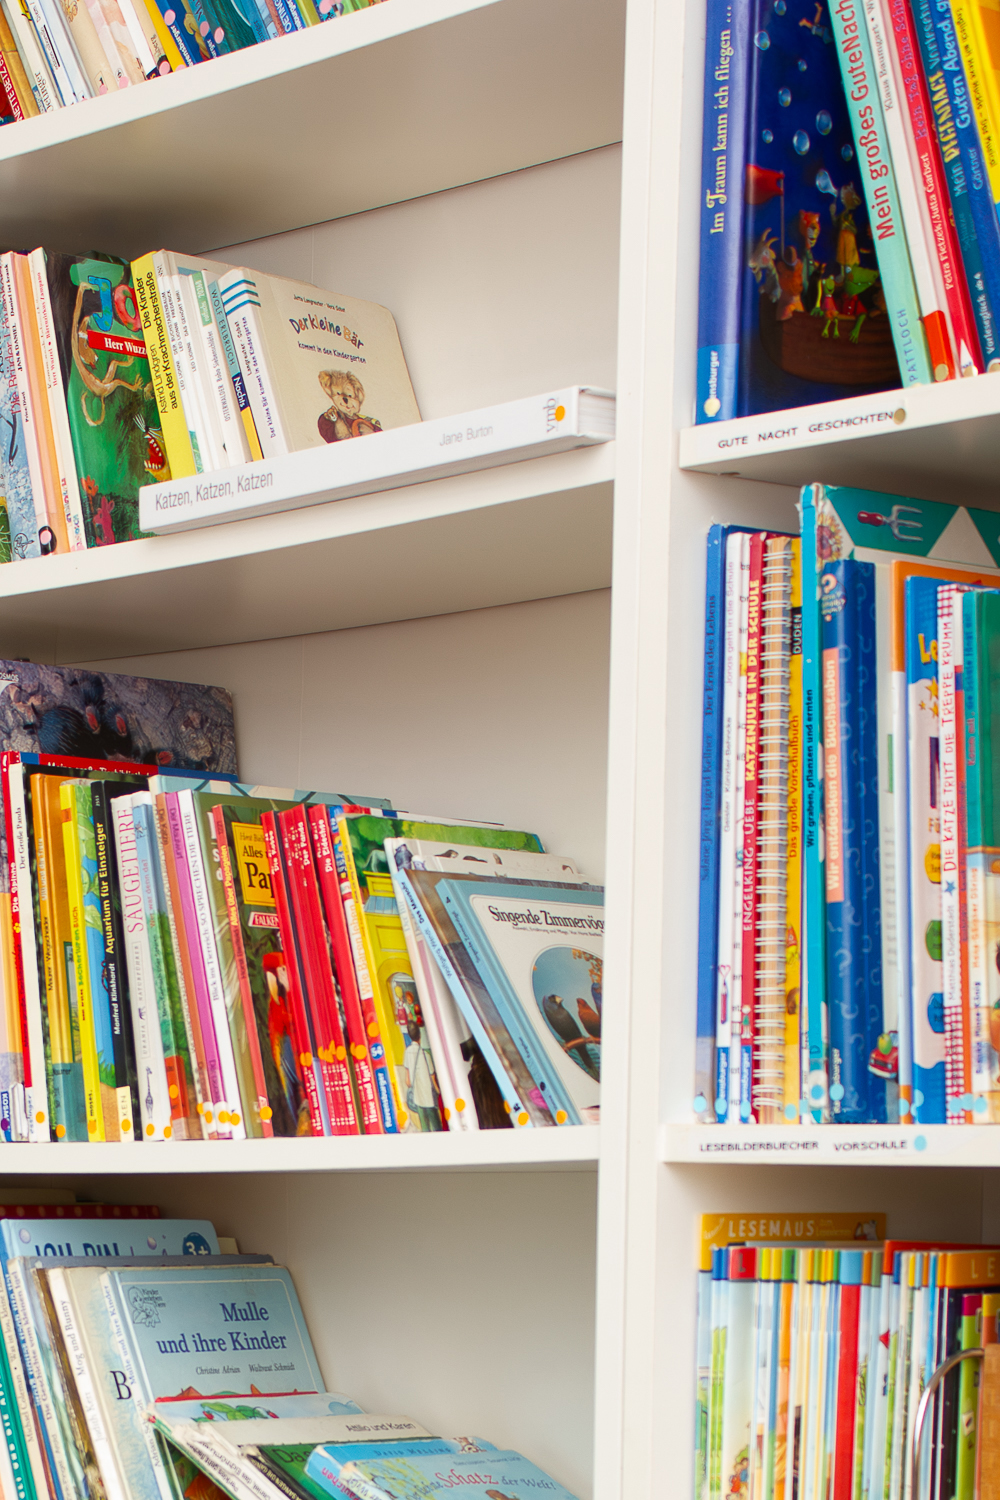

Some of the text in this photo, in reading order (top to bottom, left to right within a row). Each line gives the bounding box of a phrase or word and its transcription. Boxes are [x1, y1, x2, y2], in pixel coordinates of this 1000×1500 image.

[936, 14, 970, 128] Guten Abend,
[706, 30, 733, 233] Im Traum kann ich fliegen
[836, 0, 894, 240] Mein großes GuteNach
[136, 277, 151, 328] Die Kinder
[145, 271, 177, 409] aus der Krachmacherstraße
[289, 316, 308, 334] Der
[343, 325, 364, 349] Bär
[897, 309, 916, 381] PATTLOCH
[149, 343, 167, 413] Astrid Lindgren
[233, 376, 245, 407] Nachts
[439, 422, 494, 448] Jane Burton
[718, 411, 894, 449] GUTE NACHT GESCHICHTEN
[155, 470, 273, 512] Katzen, Katzen, Katzen
[748, 579, 759, 633] SCHULE
[747, 637, 757, 665] DER
[792, 614, 802, 653] DUDEN
[747, 672, 756, 688] IN
[941, 672, 953, 726] TREPPE
[745, 692, 757, 780] KATZENJULE
[944, 734, 953, 752] DIE
[943, 761, 953, 793] TRITT
[942, 800, 955, 841] KATZE
[117, 808, 142, 932] SÄUGETIERE
[942, 849, 956, 871] DIE
[96, 822, 114, 953] Aquarium für Einsteiger
[488, 905, 543, 926] Singende
[540, 910, 604, 933] Zimmervög
[700, 1140, 908, 1152] LESEBILDERBUECHER VORSCHULE
[728, 1220, 814, 1238] LESEMAUS
[219, 1302, 270, 1323] Mulle
[157, 1331, 288, 1355] und ihre Kinder
[435, 1469, 556, 1490] Schatz der Welt!
